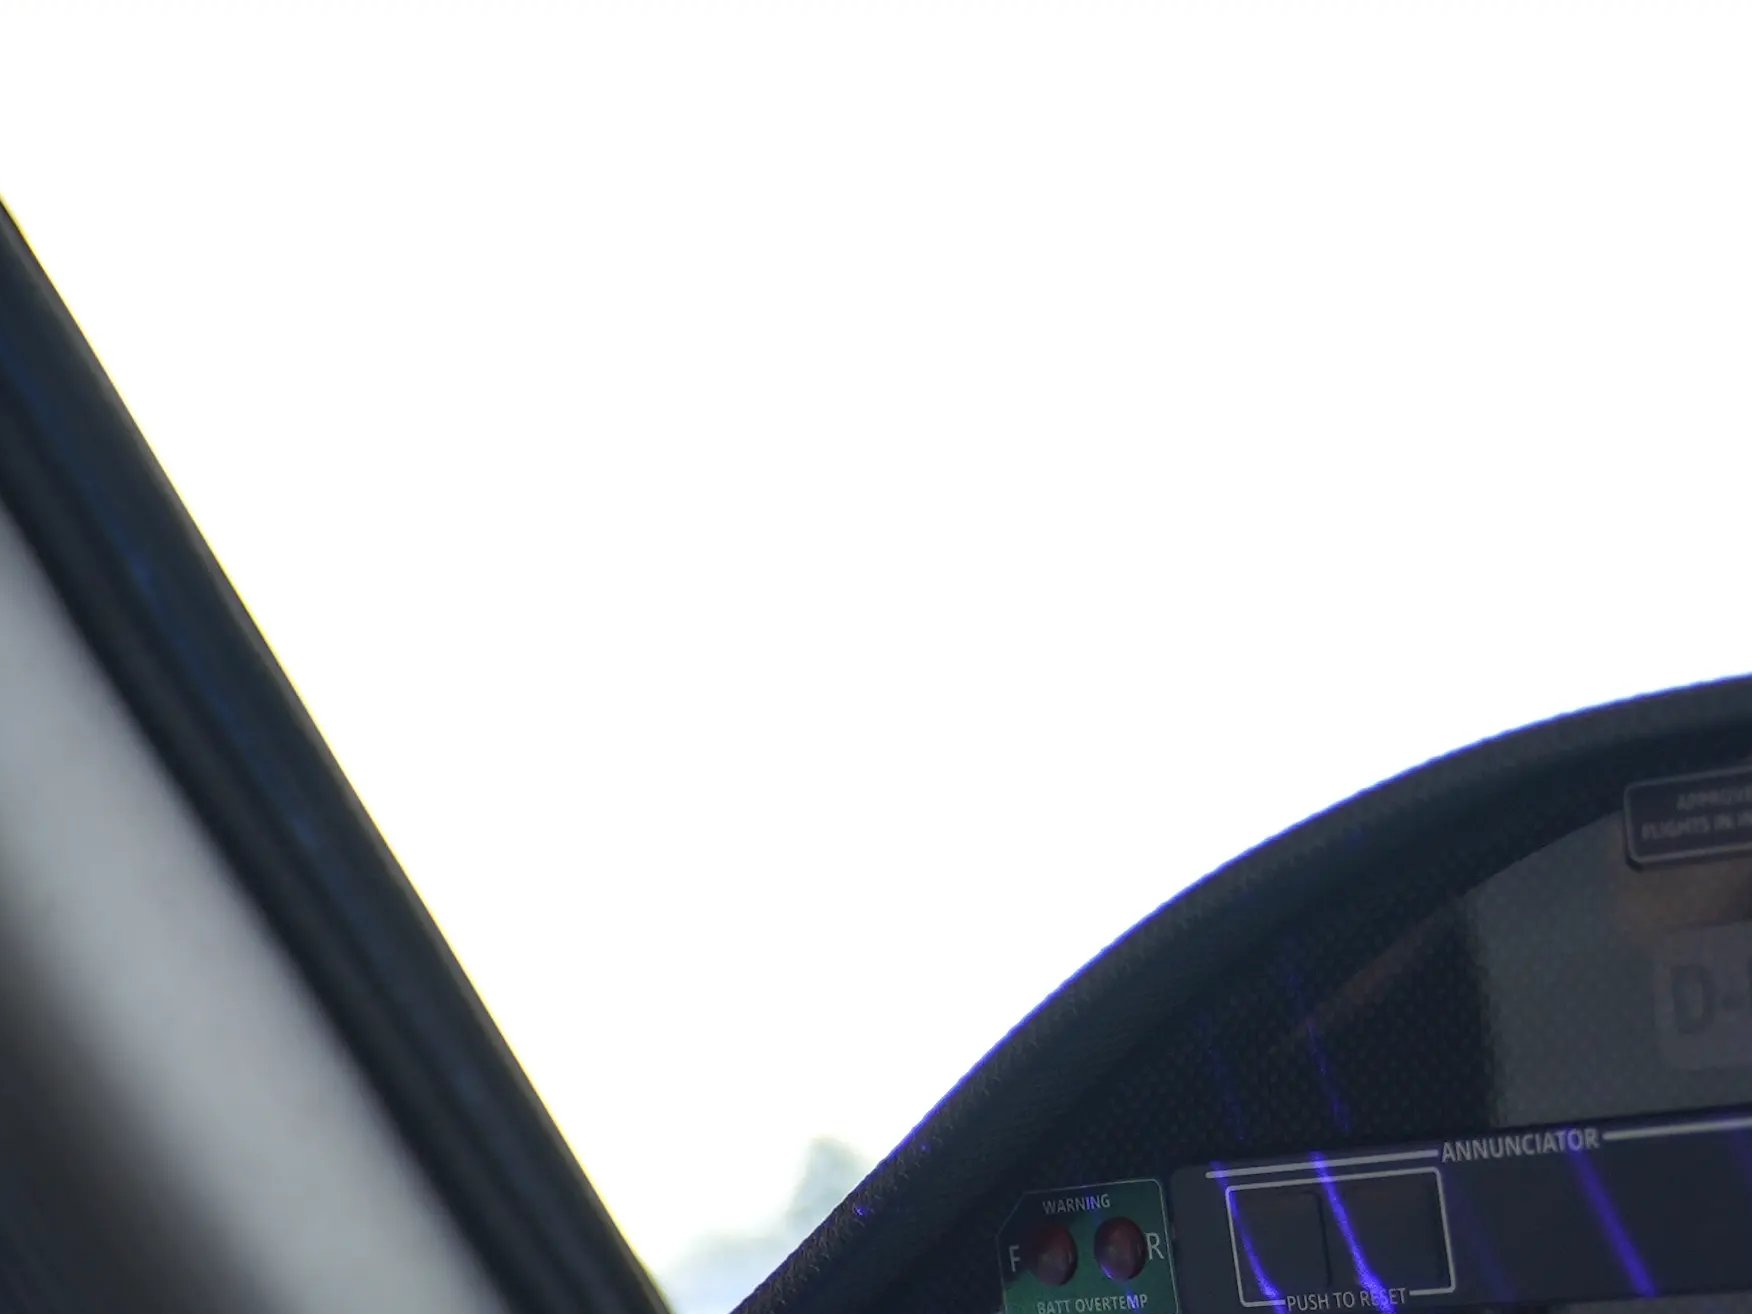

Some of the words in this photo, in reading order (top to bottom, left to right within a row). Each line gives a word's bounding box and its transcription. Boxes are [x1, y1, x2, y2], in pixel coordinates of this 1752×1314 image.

[1441, 1127, 1601, 1162] ANNUNCIATOR
[1042, 1192, 1111, 1216] WARNING
[1009, 1243, 1021, 1272] F
[1146, 1230, 1164, 1261] R
[1074, 1293, 1149, 1314] OVERTEMP
[1286, 1290, 1327, 1313] PUSH
[1330, 1289, 1356, 1309] TO
[1361, 1287, 1409, 1309] RESET
